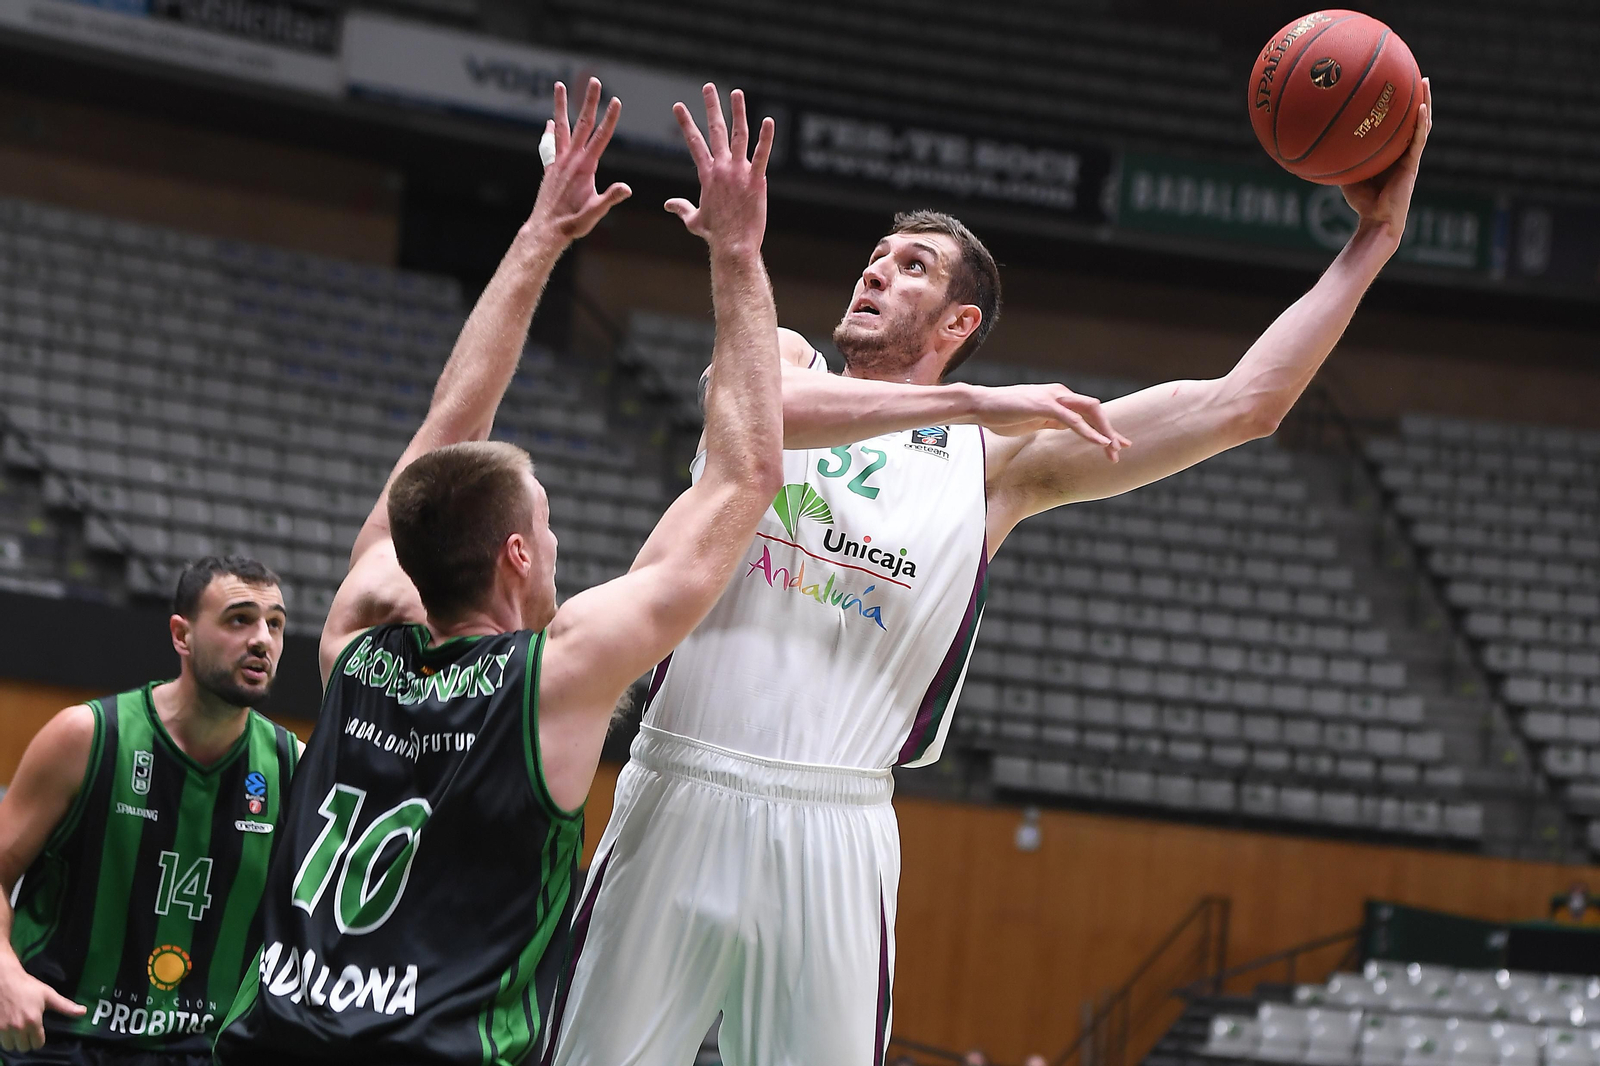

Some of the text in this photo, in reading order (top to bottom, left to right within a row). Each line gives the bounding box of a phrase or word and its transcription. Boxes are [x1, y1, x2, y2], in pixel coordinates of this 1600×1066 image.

[1256, 12, 1332, 113] SPALDING
[817, 444, 887, 500] 32
[904, 443, 949, 459] oneteam
[823, 528, 916, 578] Unicaja
[746, 543, 887, 632] Andalucía
[115, 802, 159, 822] SPALDING
[154, 850, 213, 921] 14
[291, 782, 432, 935] 10
[100, 985, 217, 1011] FUNDCIÓN
